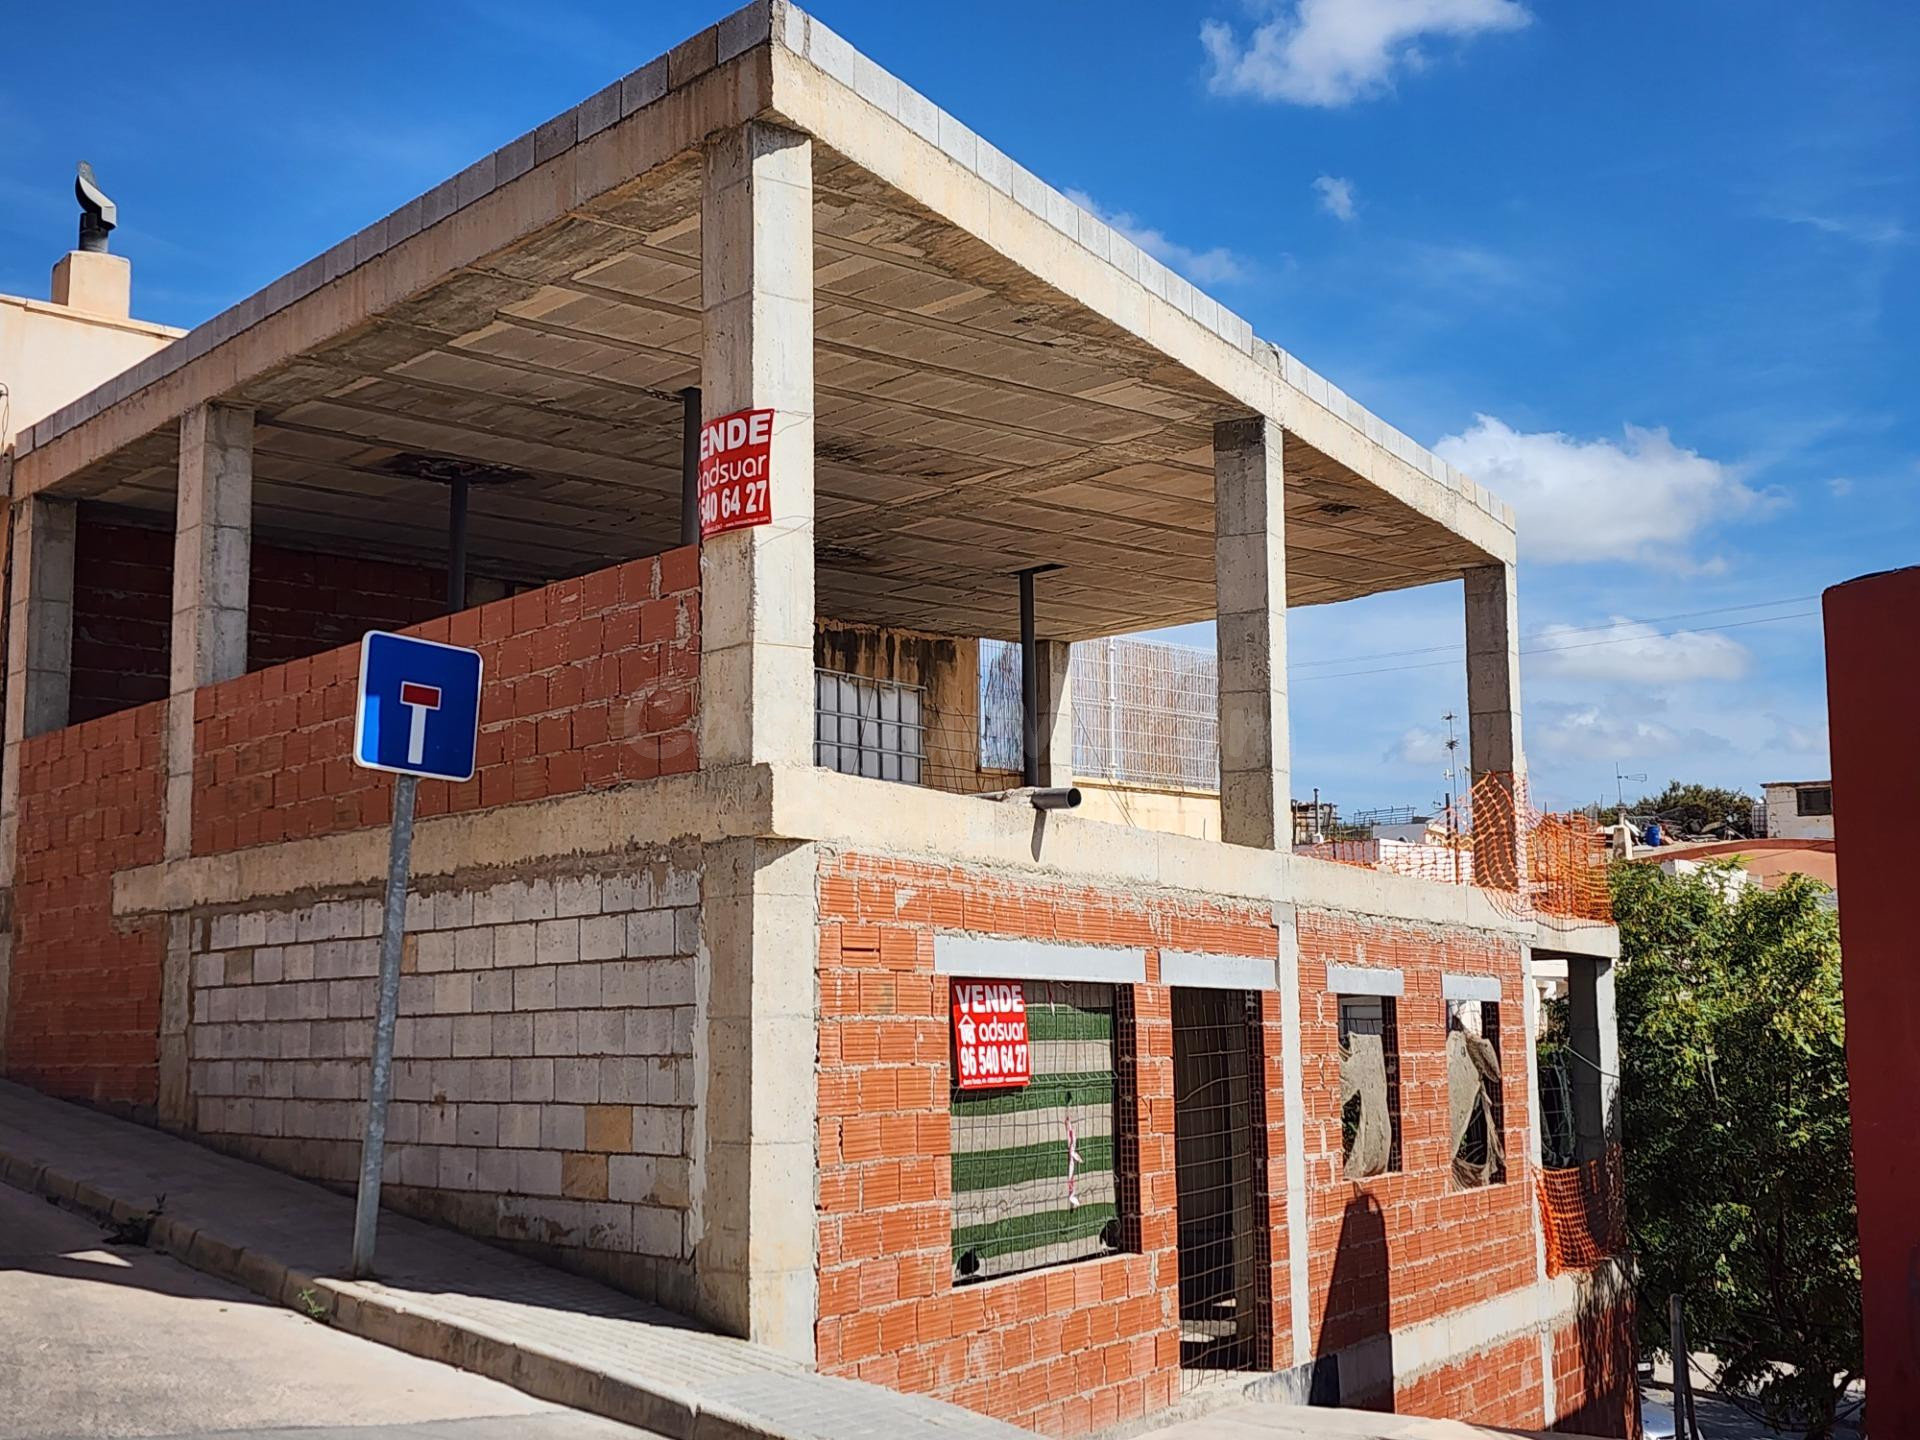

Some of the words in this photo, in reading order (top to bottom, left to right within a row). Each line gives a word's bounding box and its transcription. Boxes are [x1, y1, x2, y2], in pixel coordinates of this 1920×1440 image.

[702, 454, 767, 492] adsuar
[722, 485, 741, 519] 64
[745, 479, 767, 514] 27
[955, 985, 1024, 1014] VENDE
[978, 1015, 1025, 1042] adsuar
[960, 1046, 977, 1076] 96
[978, 1045, 1000, 1075] 540
[1000, 1044, 1015, 1074] 64
[1015, 1044, 1028, 1073] 27
